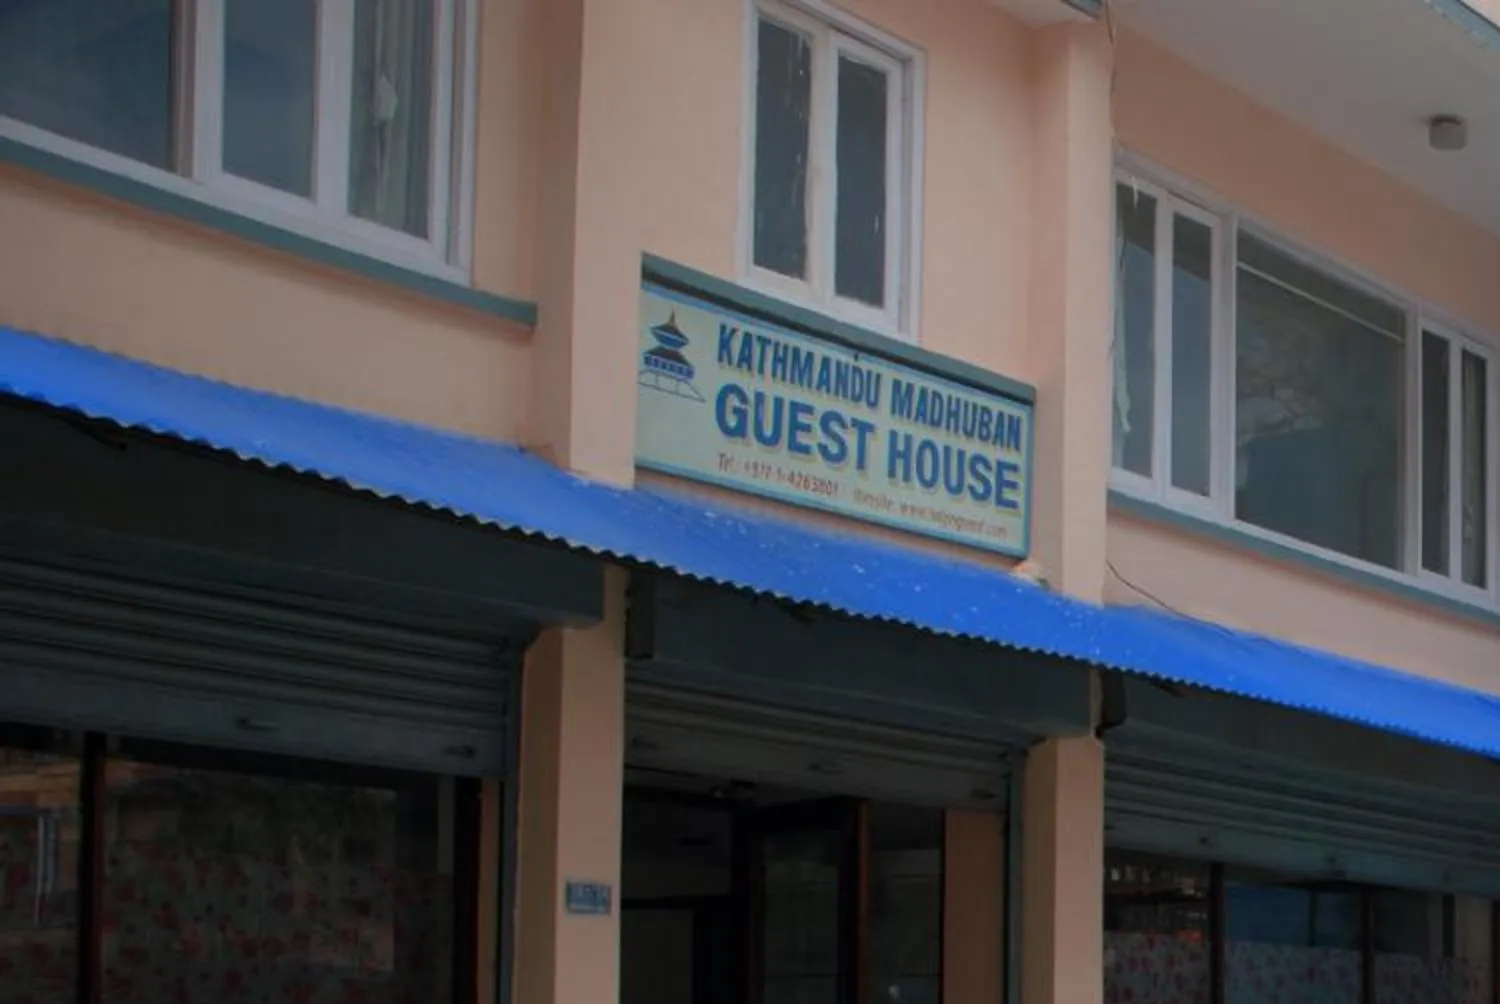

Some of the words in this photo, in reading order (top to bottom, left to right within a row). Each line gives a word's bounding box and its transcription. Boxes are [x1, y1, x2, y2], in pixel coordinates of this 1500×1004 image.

[715, 383, 876, 471] GUEST
[887, 429, 1020, 510] HOUSE
[717, 323, 882, 408] KATHMANDU
[890, 378, 1021, 452] MADHUBAN
